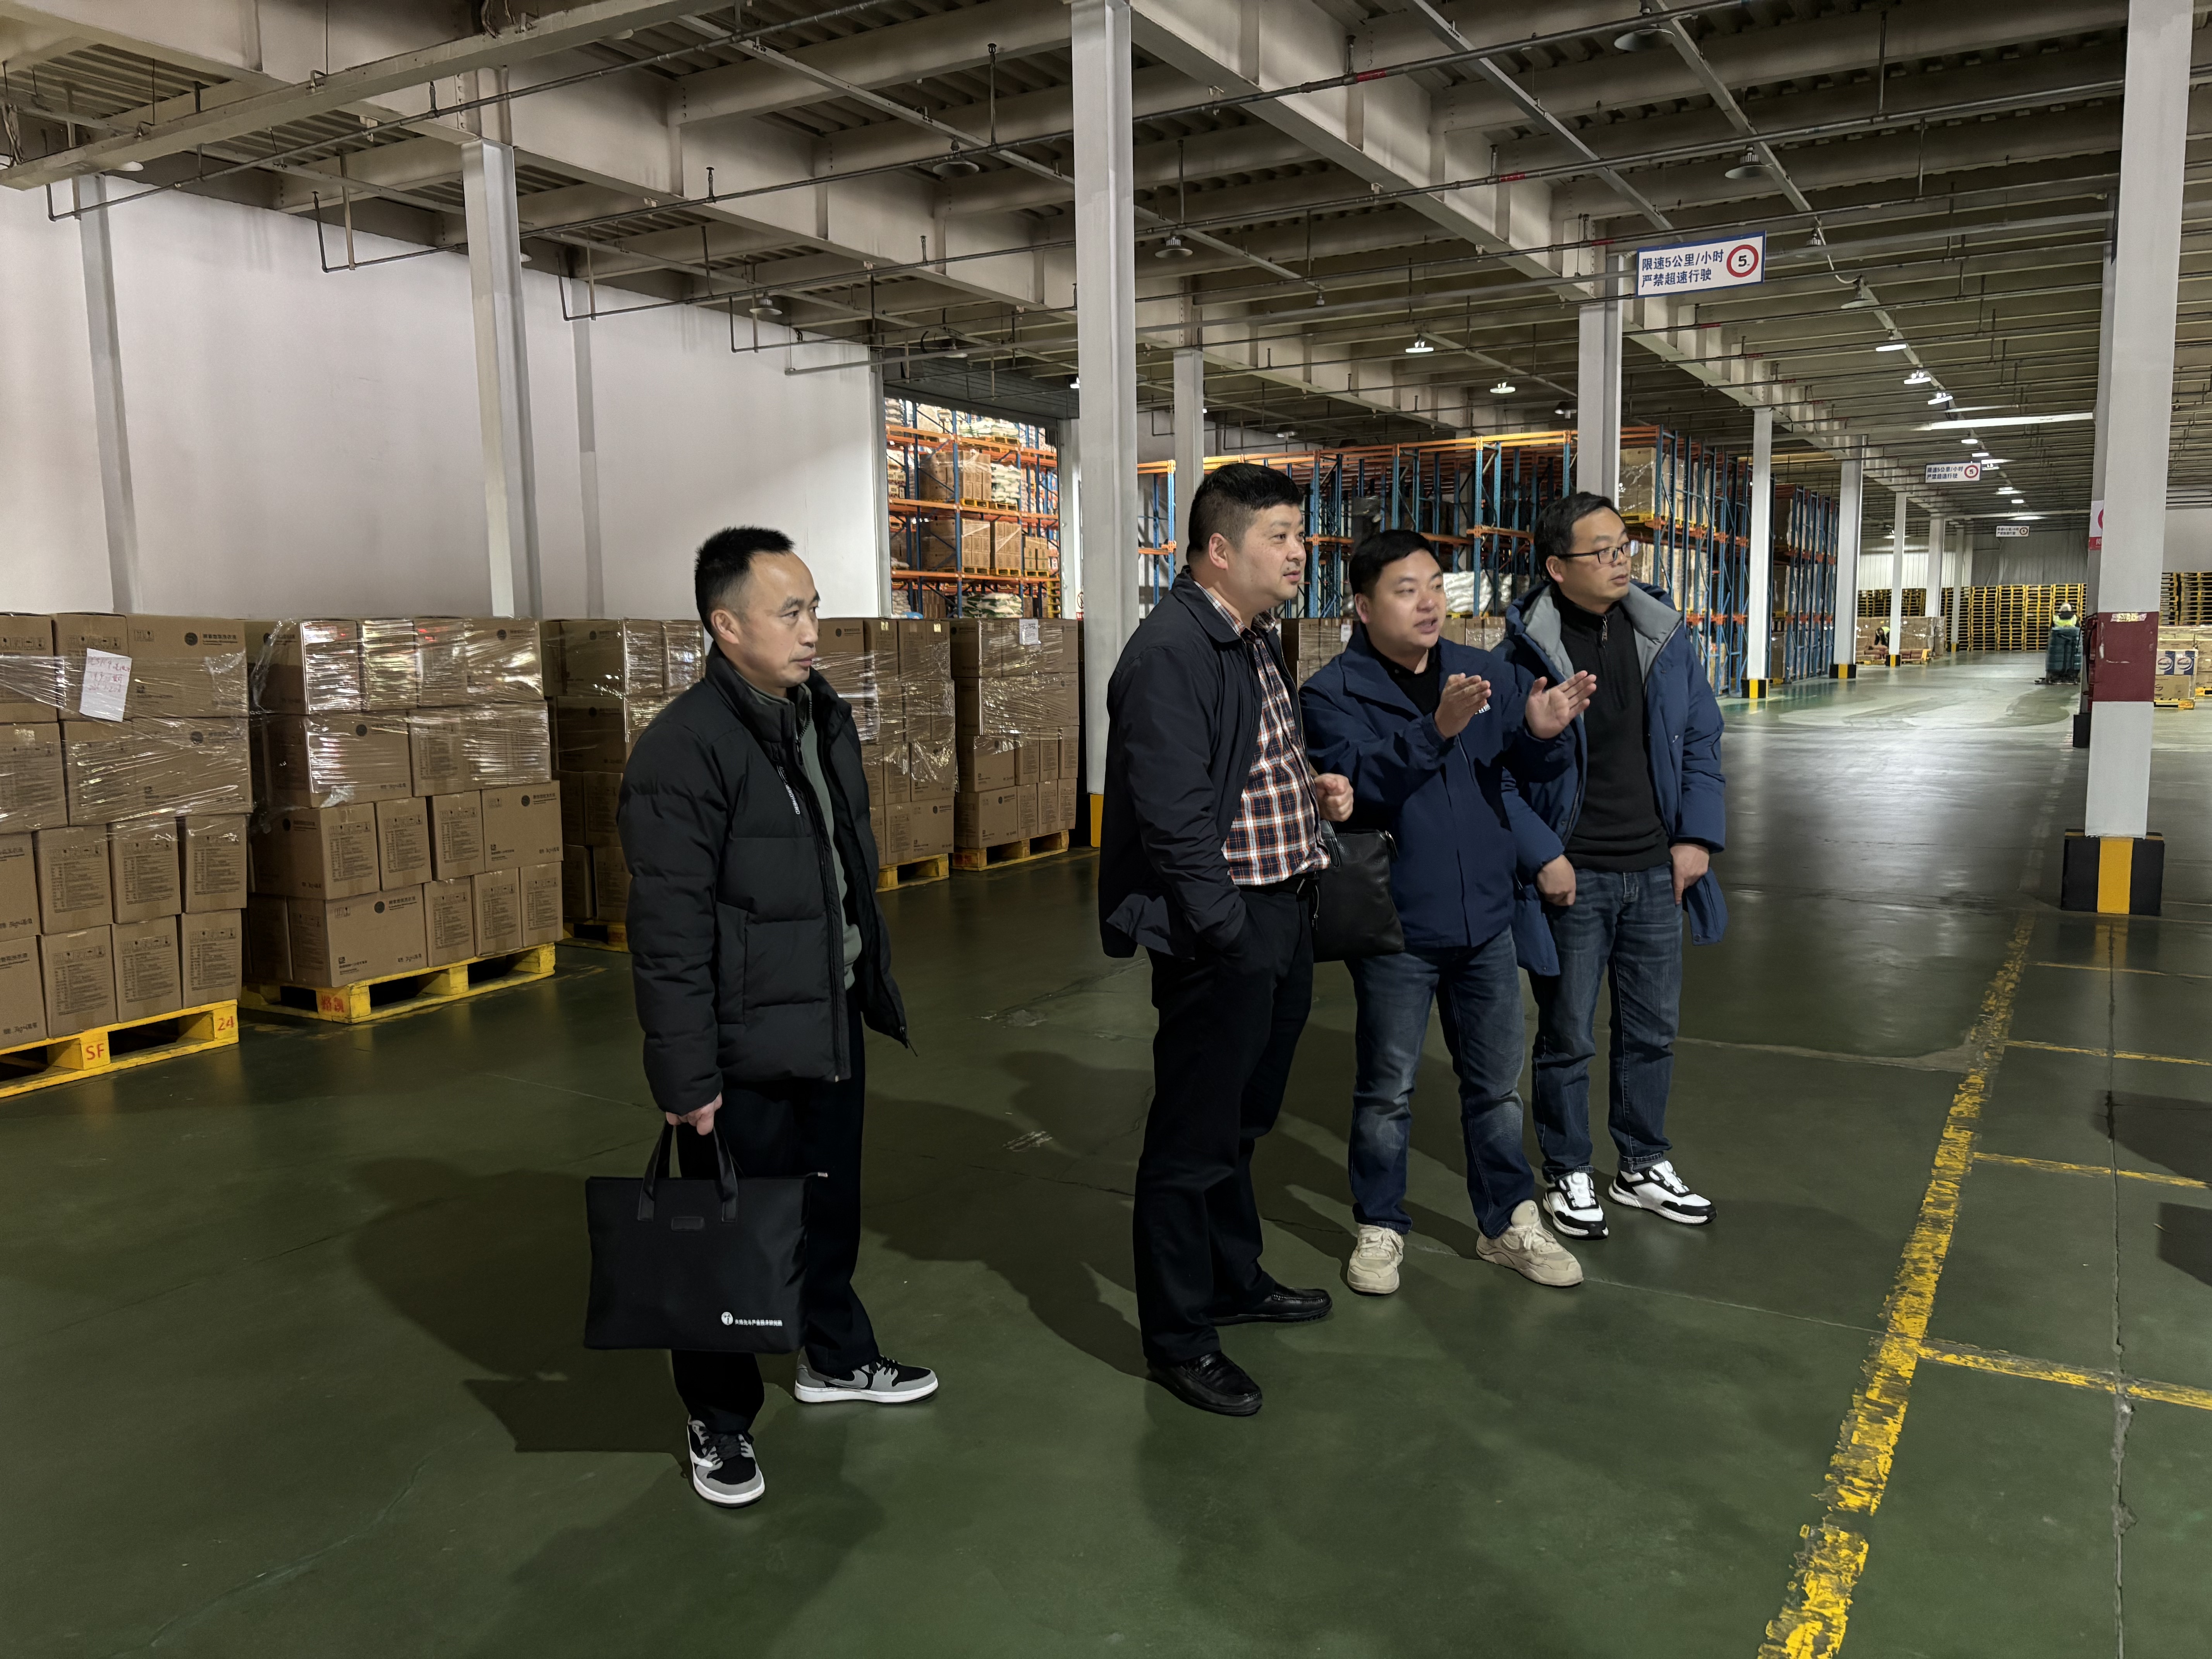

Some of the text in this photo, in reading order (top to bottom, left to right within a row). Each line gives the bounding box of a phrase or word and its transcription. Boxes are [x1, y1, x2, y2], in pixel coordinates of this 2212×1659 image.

[1642, 249, 1724, 271] 限速5公里/小时
[1738, 255, 1747, 267] 5
[1642, 268, 1712, 287] 严禁超速行驶
[218, 1015, 234, 1031] 24
[86, 1043, 104, 1060] SF
